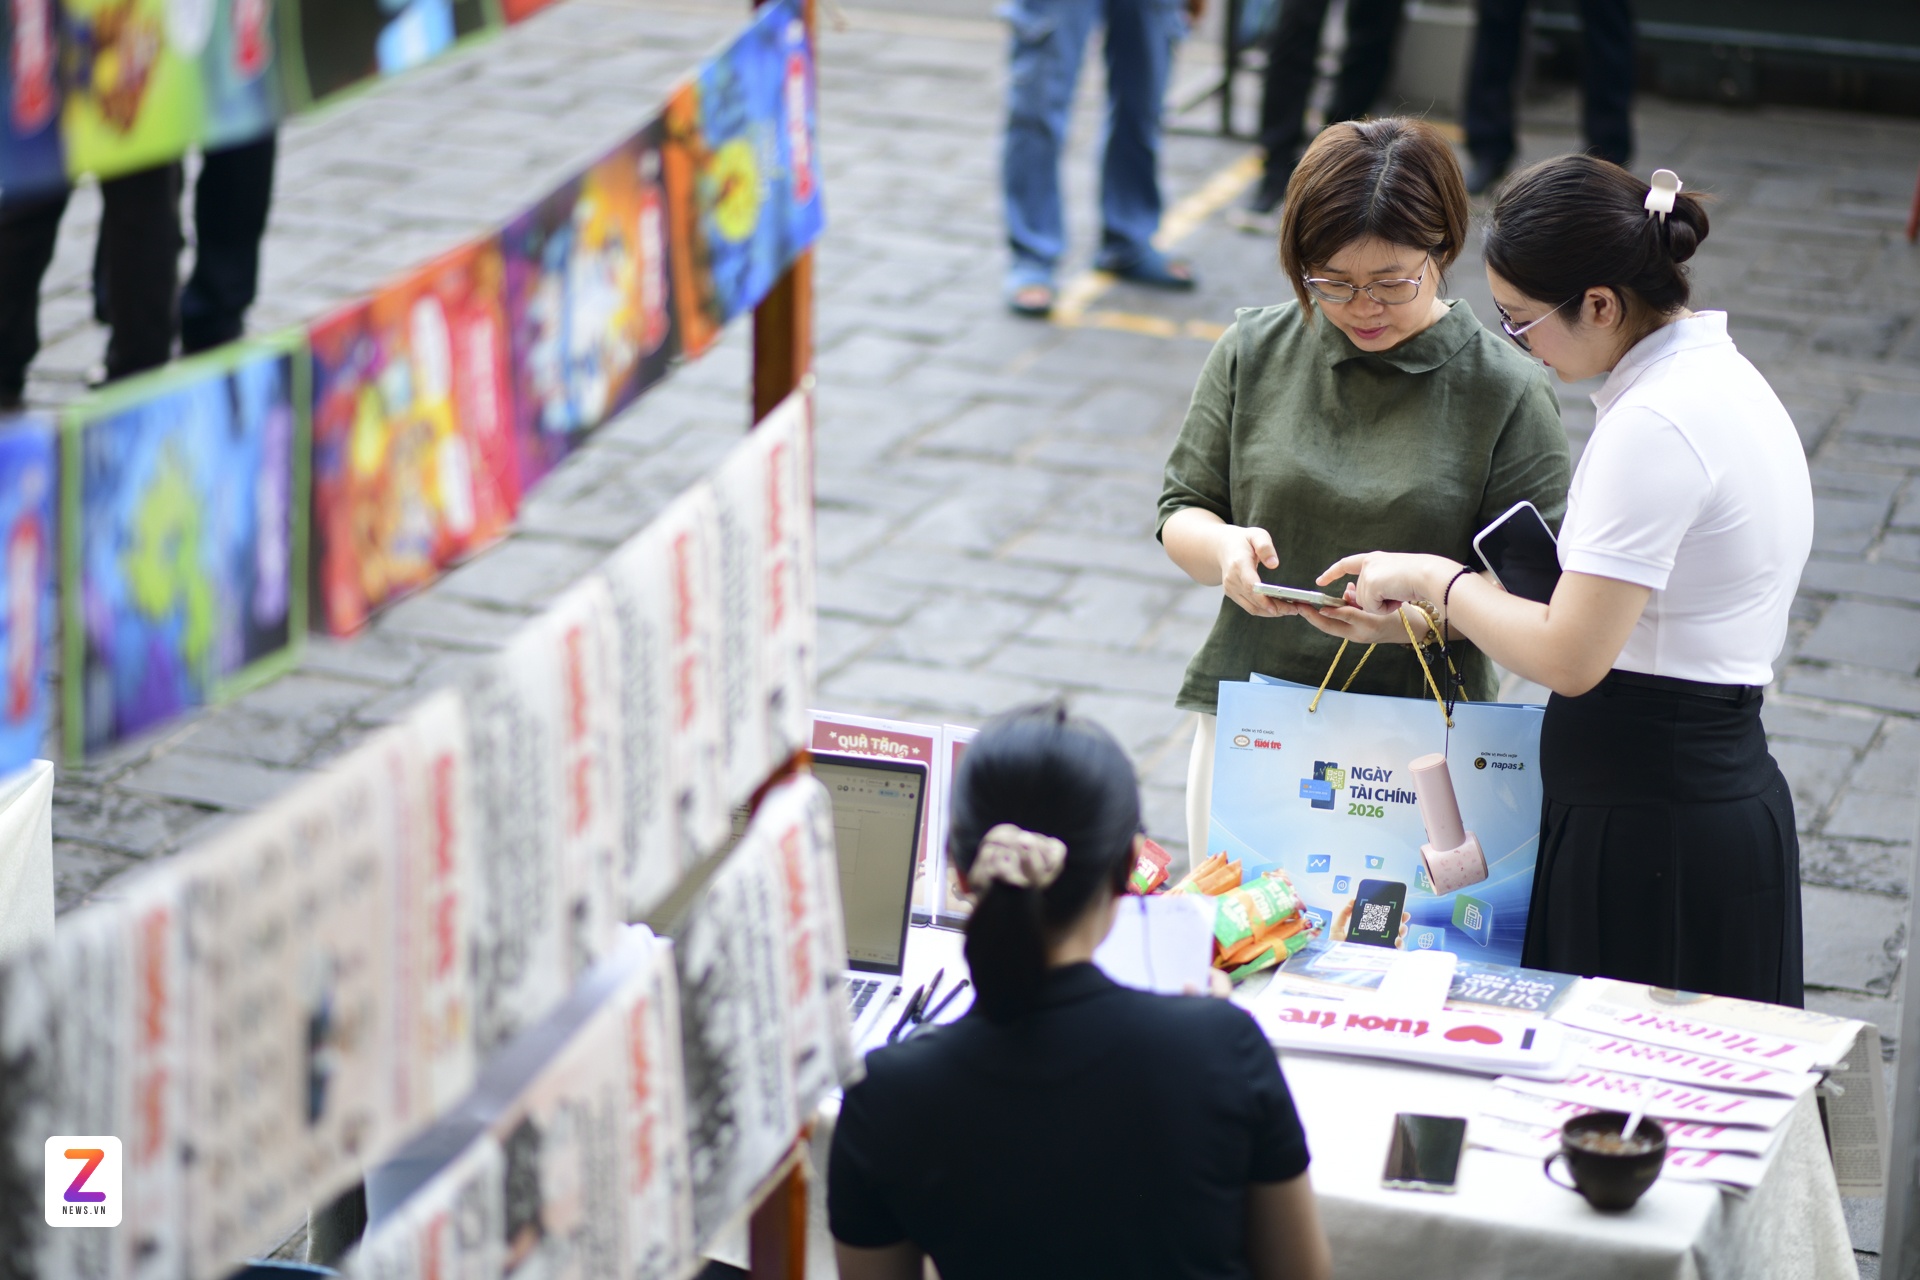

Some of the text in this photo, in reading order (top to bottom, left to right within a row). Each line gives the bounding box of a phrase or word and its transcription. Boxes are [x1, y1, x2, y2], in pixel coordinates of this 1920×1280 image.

[838, 733, 868, 749] QUÀ
[1351, 766, 1393, 783] NGÀY
[1349, 783, 1372, 800] TÀI
[1347, 802, 1384, 818] 2026
